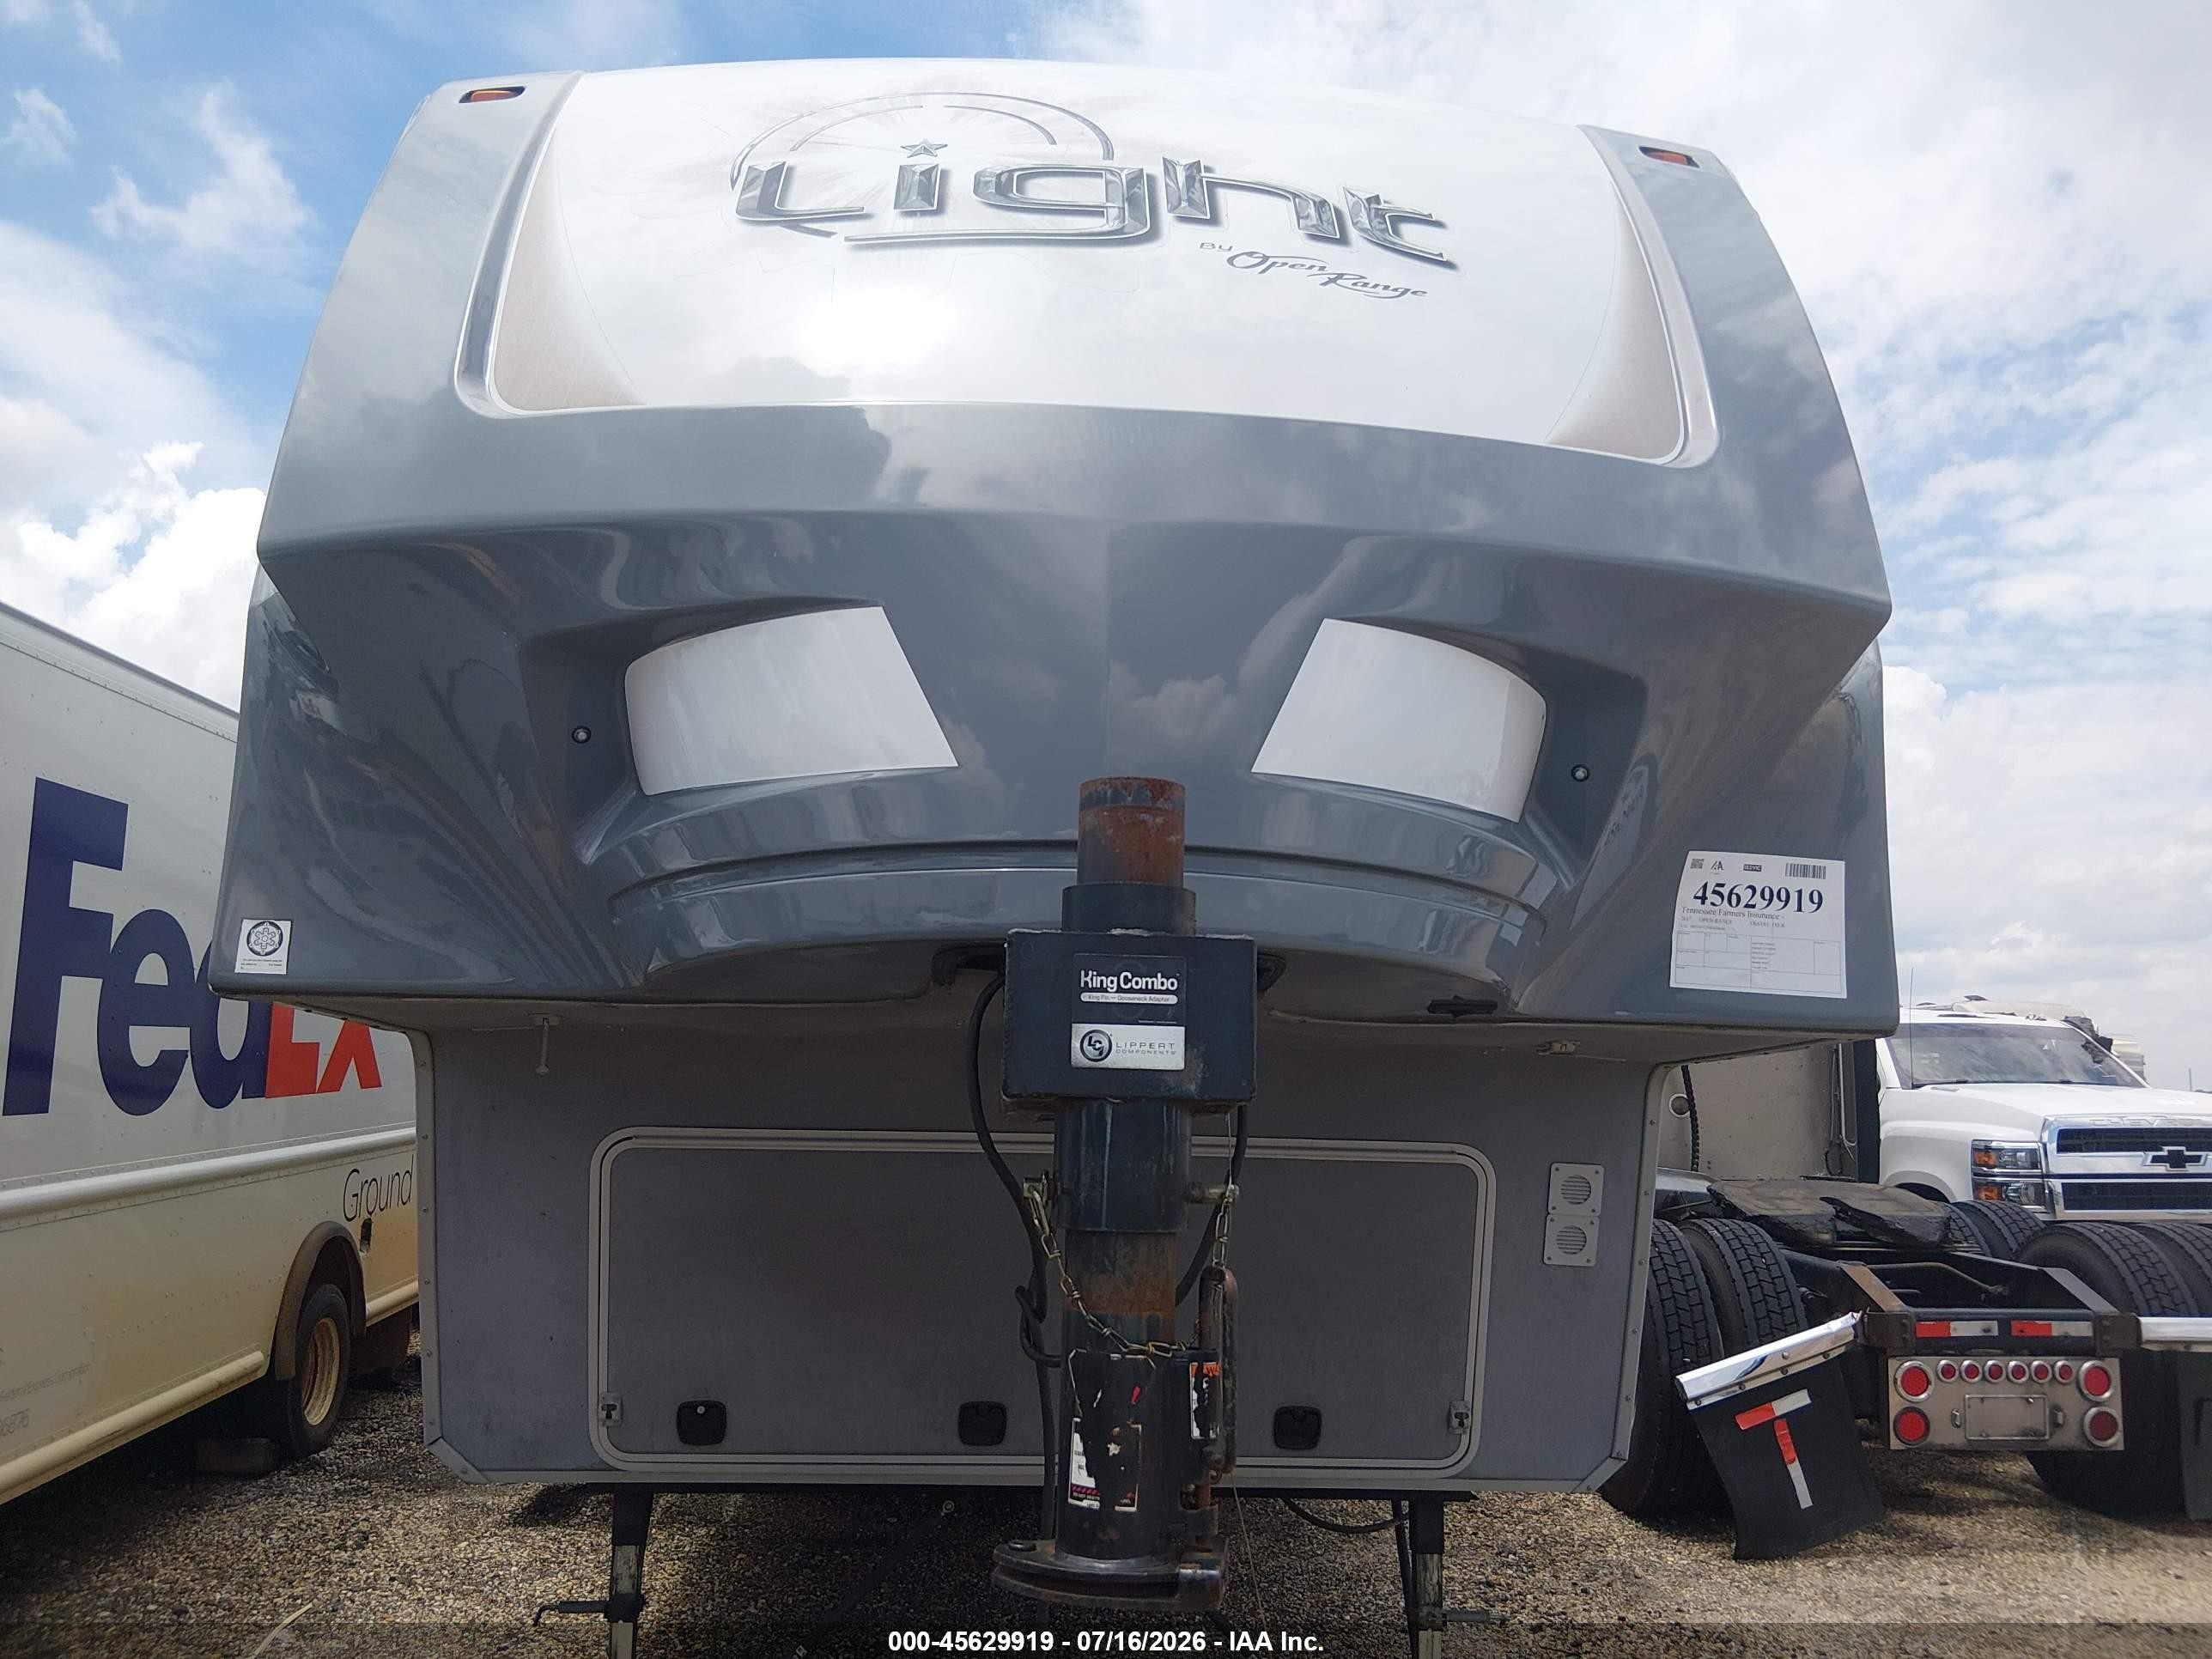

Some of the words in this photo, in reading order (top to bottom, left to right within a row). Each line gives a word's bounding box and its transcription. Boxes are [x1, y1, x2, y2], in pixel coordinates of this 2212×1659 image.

[1226, 251, 1330, 275] Open
[1306, 272, 1429, 300] Range
[1692, 881, 1824, 914] 45629919
[1080, 970, 1118, 992] King
[1120, 971, 1178, 990] Combo
[1115, 1042, 1176, 1050] LIPPERT
[343, 1153, 414, 1222] Ground
